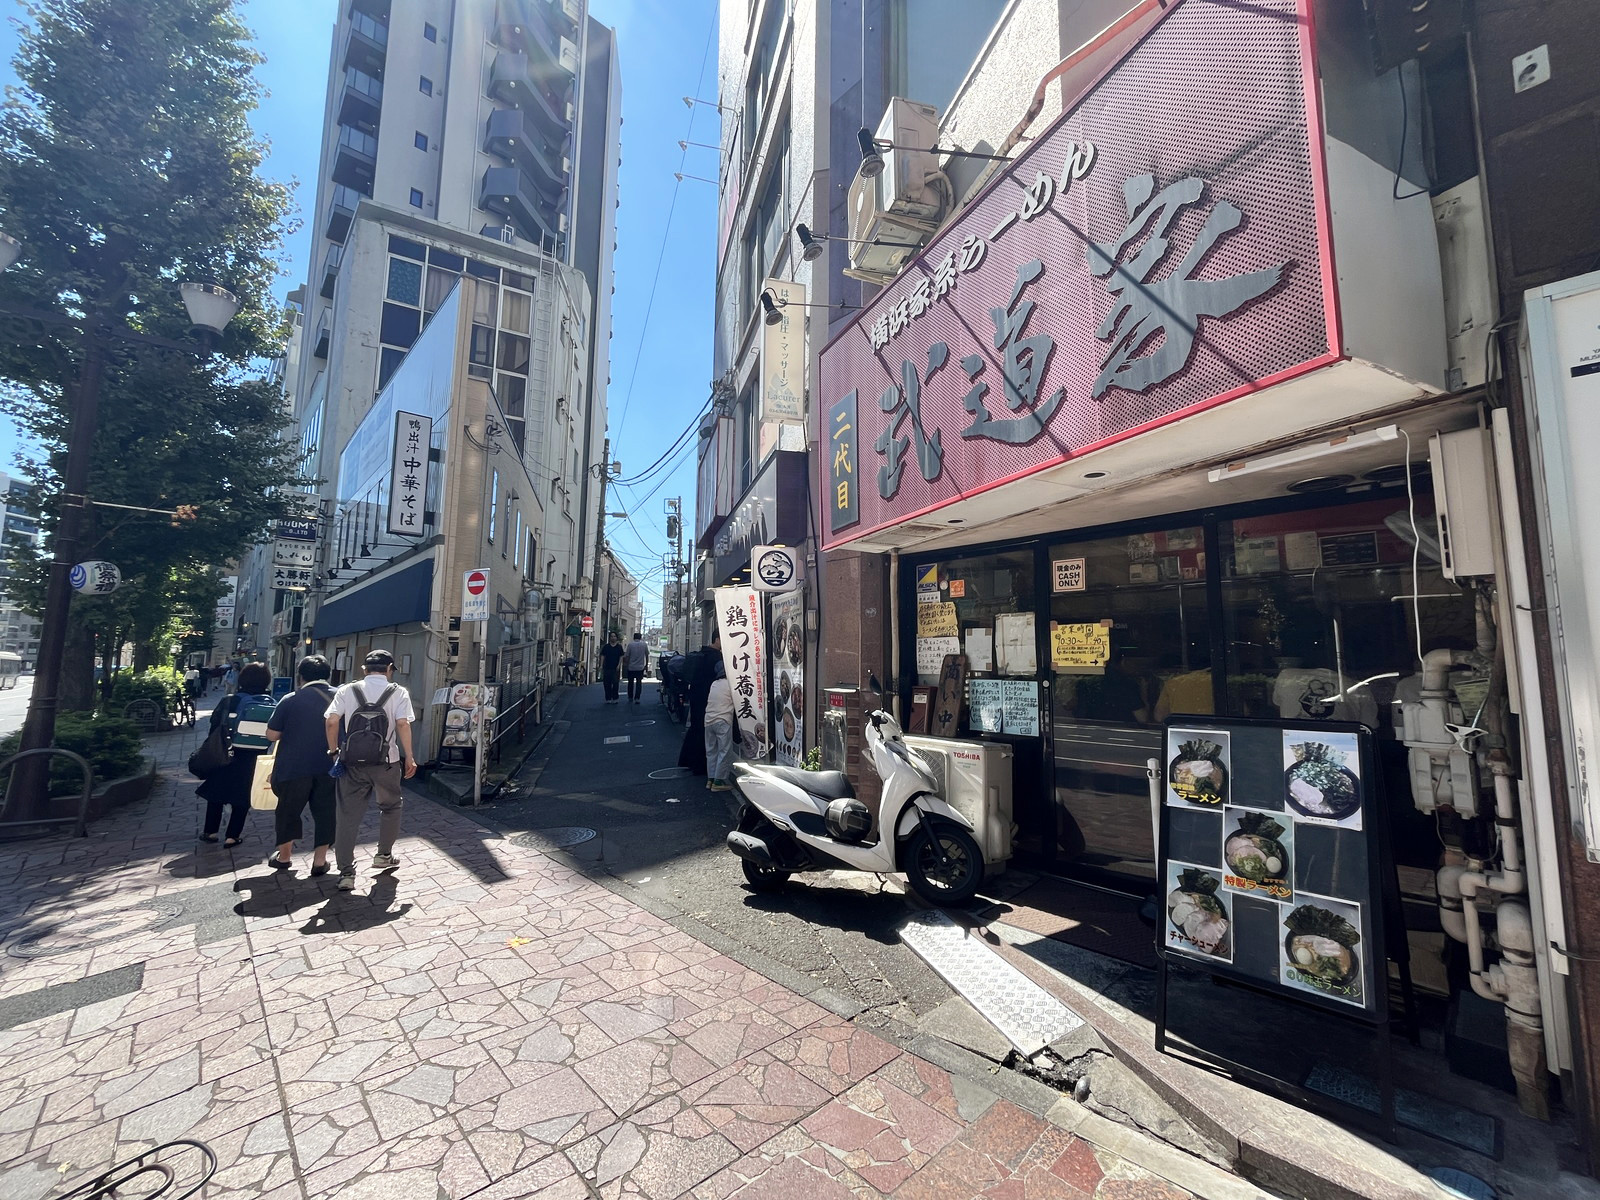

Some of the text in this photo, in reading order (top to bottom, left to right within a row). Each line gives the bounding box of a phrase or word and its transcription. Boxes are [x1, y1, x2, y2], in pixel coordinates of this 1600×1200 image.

[870, 141, 1097, 354] 横浜家系らーめん
[833, 412, 853, 511] 二代目
[275, 569, 311, 580] 大勝軒
[1056, 564, 1081, 572] 現金のみ
[1058, 571, 1080, 580] CASH
[1058, 579, 1080, 587] ONLY
[726, 605, 758, 721] 鶏つけ蕎麦
[953, 752, 981, 760] TOSHIBA
[1178, 790, 1221, 804] ラーメン
[1224, 875, 1292, 898] 特製ラーメン
[1170, 930, 1229, 953] チャーシューメン
[1286, 969, 1361, 998] のり味玉ラーメン
